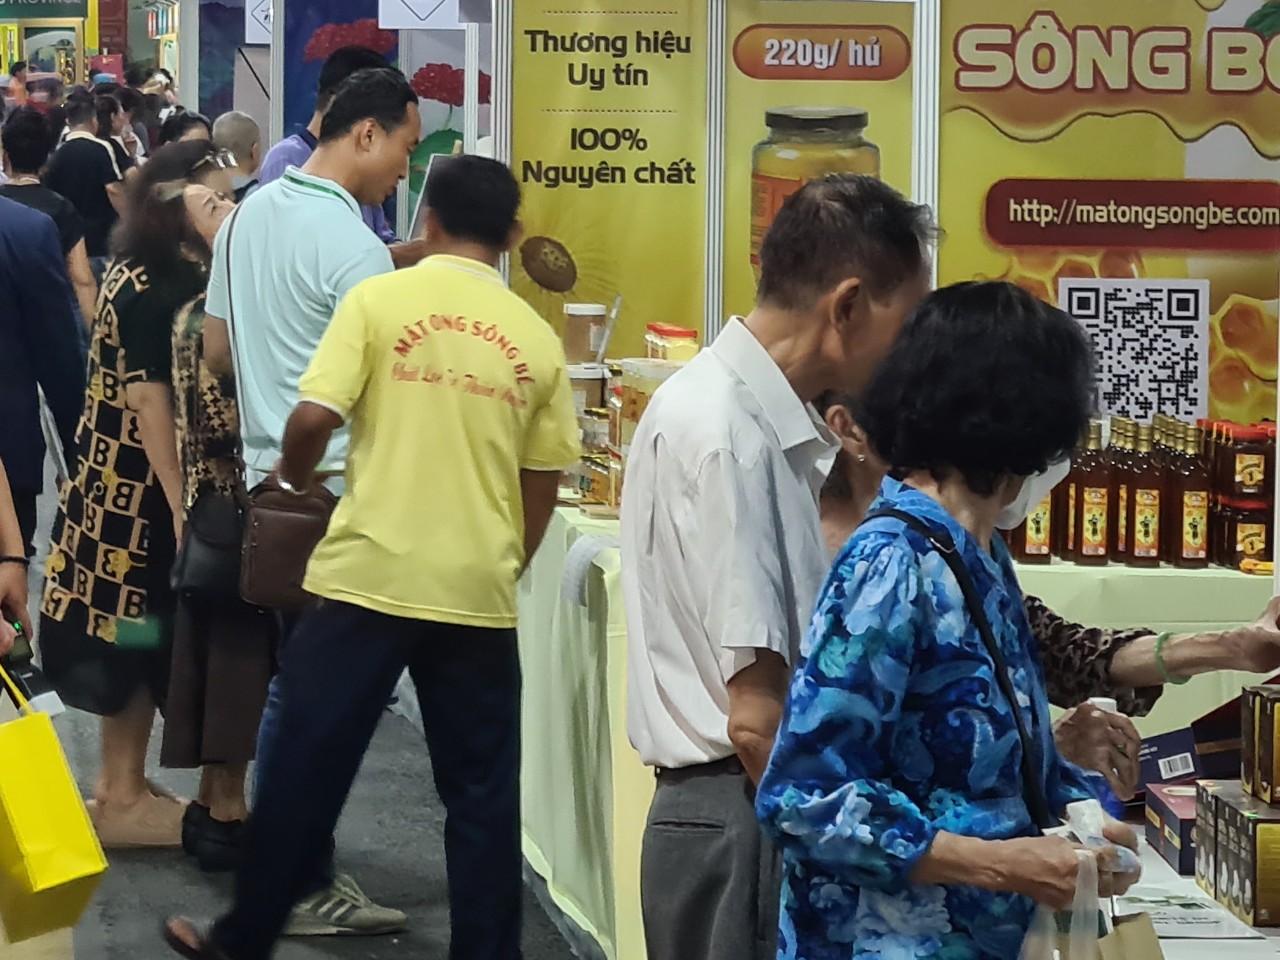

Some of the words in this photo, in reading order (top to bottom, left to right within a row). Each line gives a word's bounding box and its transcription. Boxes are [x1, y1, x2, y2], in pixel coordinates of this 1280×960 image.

[524, 29, 628, 61] Thương
[635, 29, 692, 61] hiệu
[764, 38, 842, 70] 220g/
[953, 10, 1192, 94] SÔNG
[567, 63, 606, 91] Uy
[613, 60, 649, 86] tín
[571, 127, 648, 152] 100%
[522, 159, 626, 189] Nguyên
[633, 156, 696, 185] chất
[1009, 198, 1280, 230] http://matongsongbe.com
